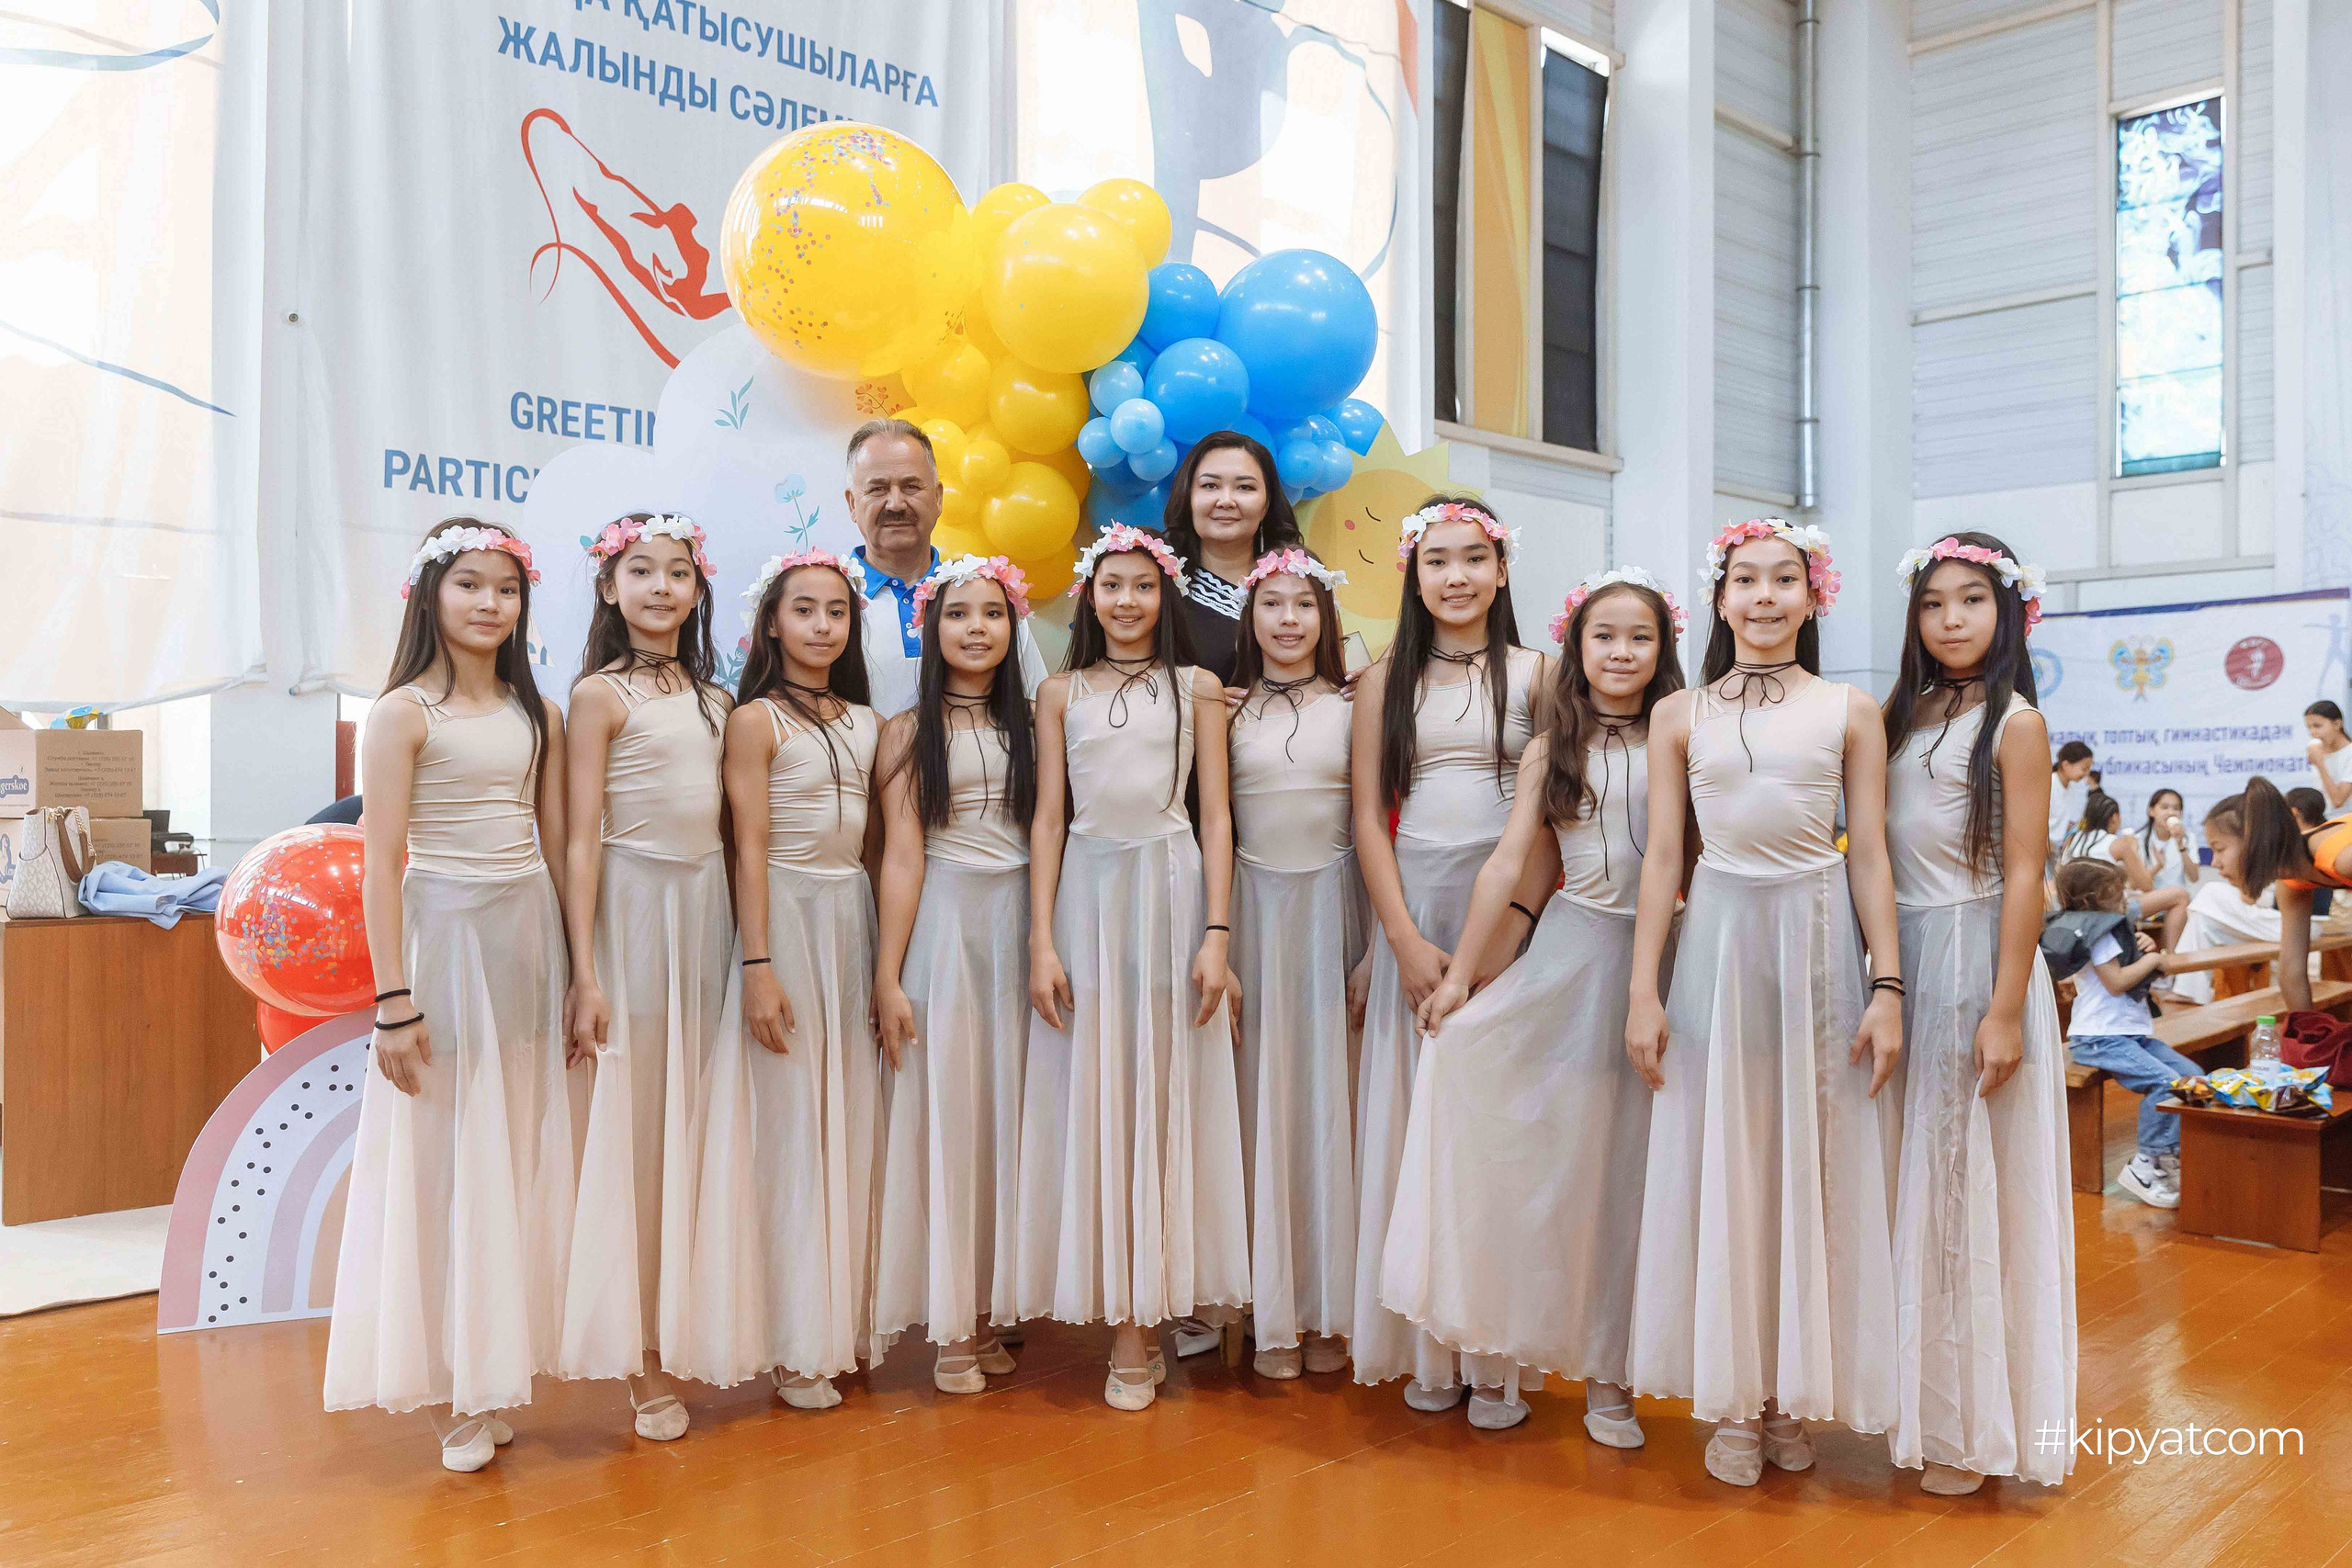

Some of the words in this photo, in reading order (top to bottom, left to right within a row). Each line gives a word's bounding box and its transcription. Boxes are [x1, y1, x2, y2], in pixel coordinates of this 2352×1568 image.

[498, 16, 718, 113] ЖАЛЫНДЫ
[729, 85, 854, 131] СӘЛЕ
[624, 0, 939, 107] ҚАТЫСУШЫЛАРҒА
[384, 449, 540, 504] PARTIC
